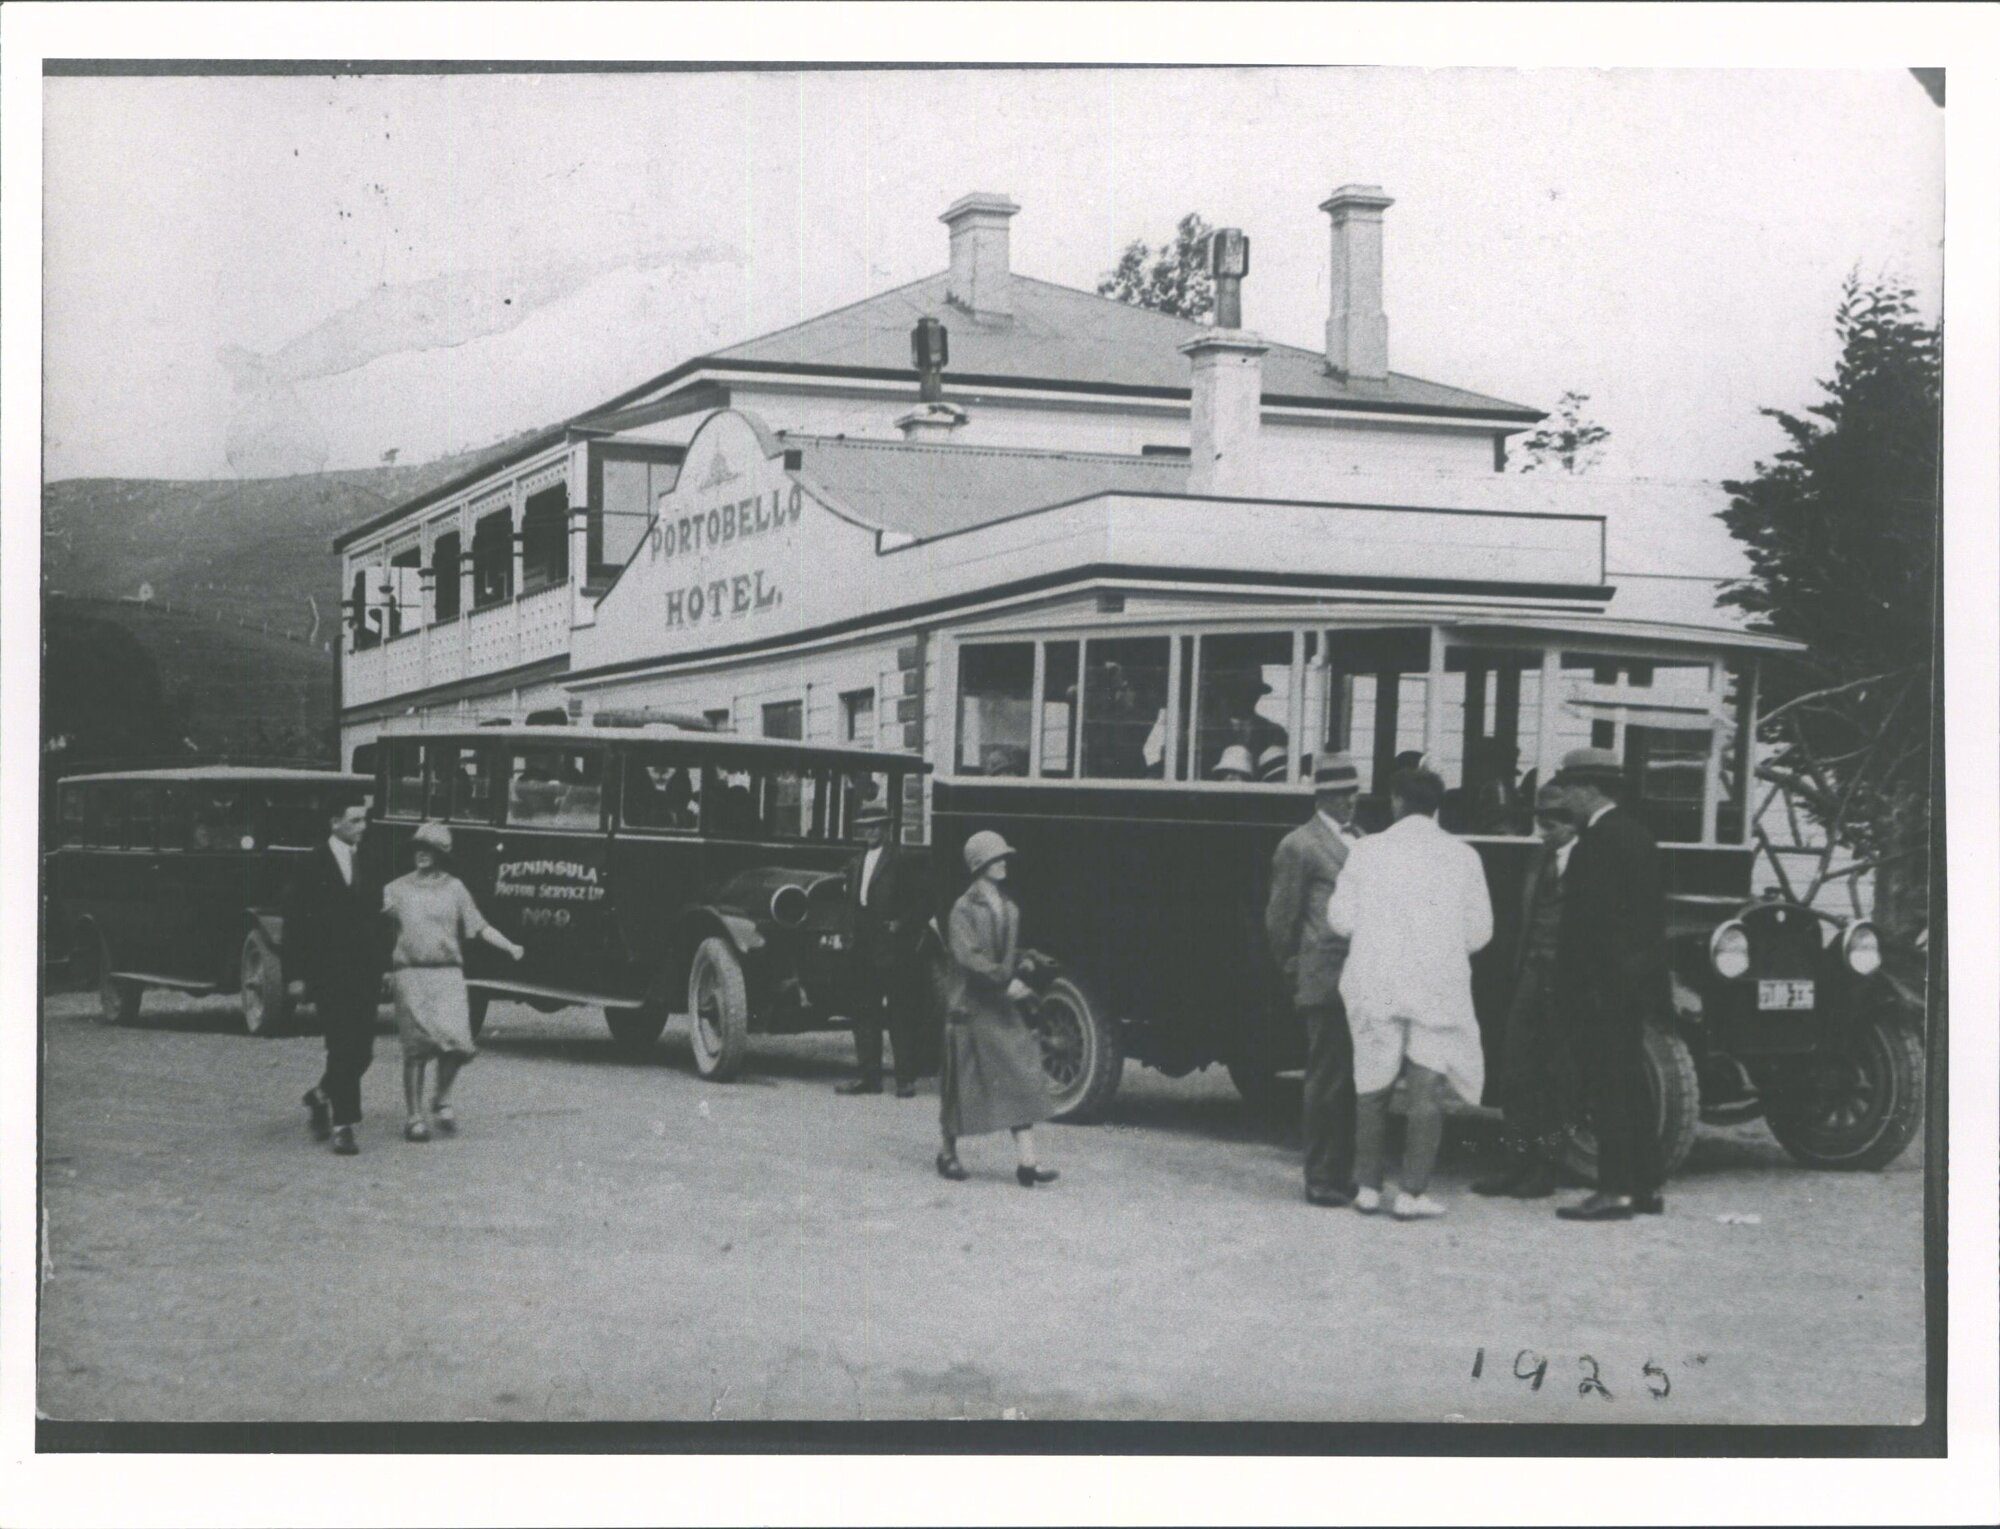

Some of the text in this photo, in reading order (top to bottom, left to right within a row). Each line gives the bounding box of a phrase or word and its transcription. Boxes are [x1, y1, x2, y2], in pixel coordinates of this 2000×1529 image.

[651, 484, 802, 561] PORTOBELLO
[497, 860, 598, 884] PENINSULA
[1471, 1347, 1671, 1401] 1925
